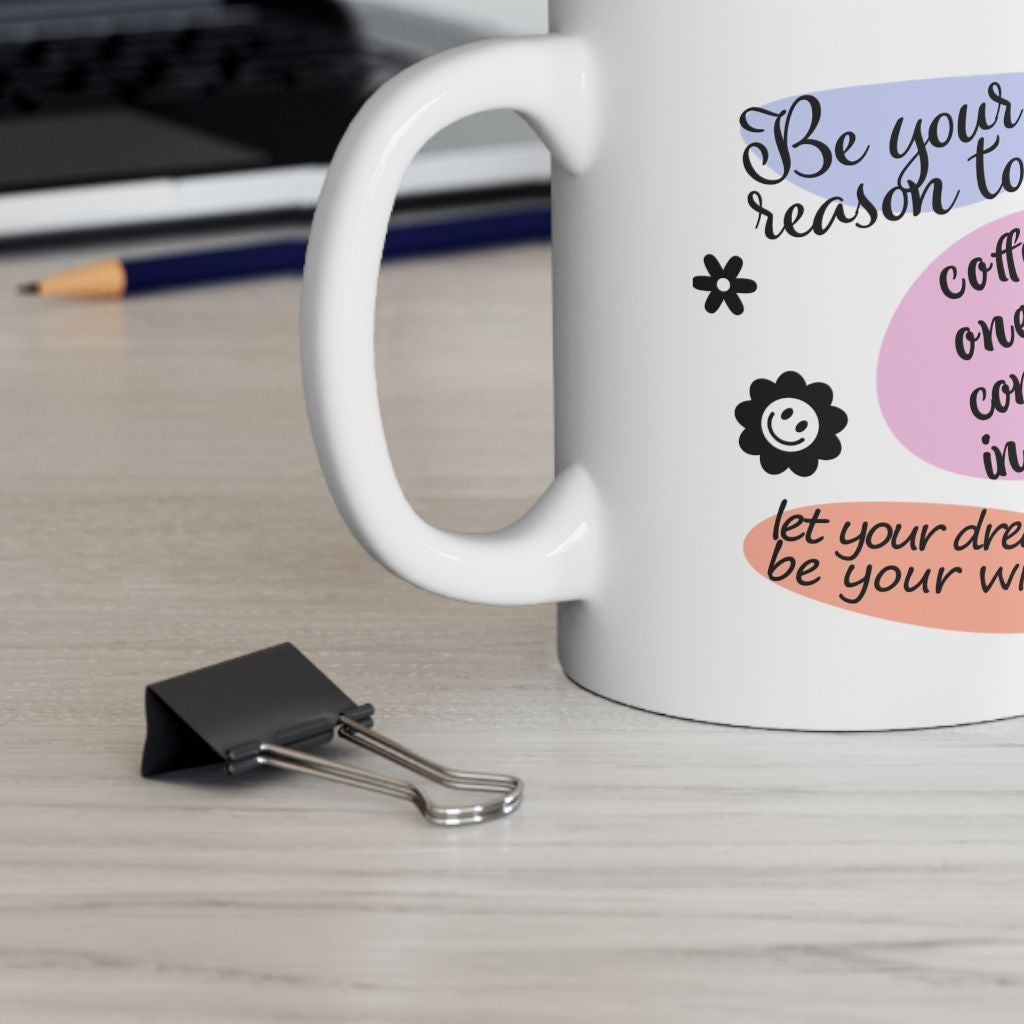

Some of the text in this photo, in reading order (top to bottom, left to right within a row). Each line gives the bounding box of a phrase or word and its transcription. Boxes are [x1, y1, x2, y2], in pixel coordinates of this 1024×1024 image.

[739, 94, 870, 185] Be
[889, 81, 1024, 193] your
[747, 177, 960, 240] reason
[967, 135, 1024, 200] to
[767, 539, 822, 586] be
[839, 563, 962, 604] your
[772, 499, 829, 544] let
[835, 520, 947, 560] your
